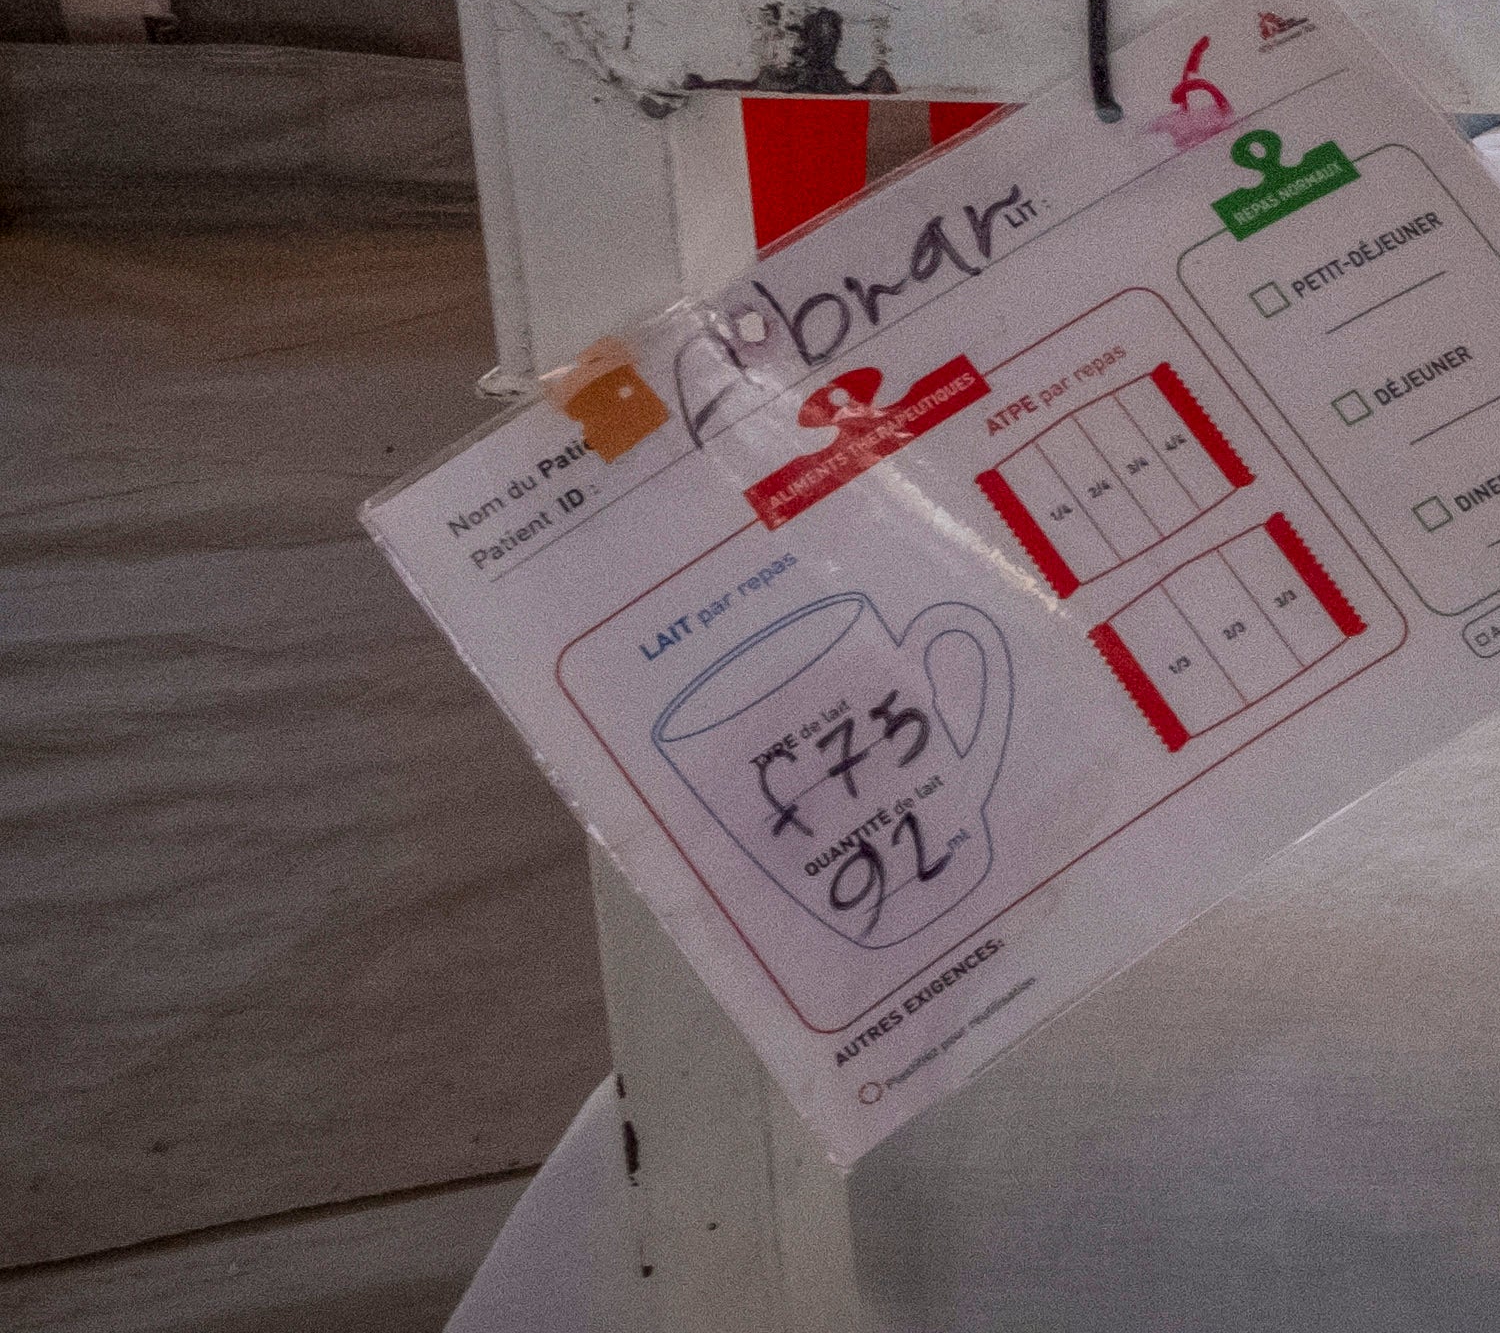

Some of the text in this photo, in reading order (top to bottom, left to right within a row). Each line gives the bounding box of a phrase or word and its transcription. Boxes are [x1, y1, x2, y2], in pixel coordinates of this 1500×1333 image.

[1002, 200, 1040, 229] LIT
[1232, 160, 1344, 225] REPAS NORMAUX
[1291, 211, 1443, 297] PETIT-DÉJEUNER
[985, 345, 1127, 436] ATPE par repas
[1373, 345, 1472, 406] DÉJEUNER
[447, 497, 505, 538] Nom
[507, 475, 537, 500] du
[769, 452, 848, 508] ALIMENTS
[1050, 504, 1074, 523] 1/4
[1088, 480, 1111, 499] 2/4
[1125, 456, 1149, 476] 3/4
[470, 511, 553, 570] Patient
[556, 488, 585, 514] ID
[638, 552, 798, 662] LAIT par repas
[1169, 656, 1191, 675] 1/3
[799, 720, 823, 742] de
[823, 700, 850, 726] lait
[803, 809, 894, 878] QUANTITÉ
[914, 774, 945, 800] lait
[835, 1010, 903, 1068] AUTRES
[902, 939, 1005, 1015] EXIGENCES:
